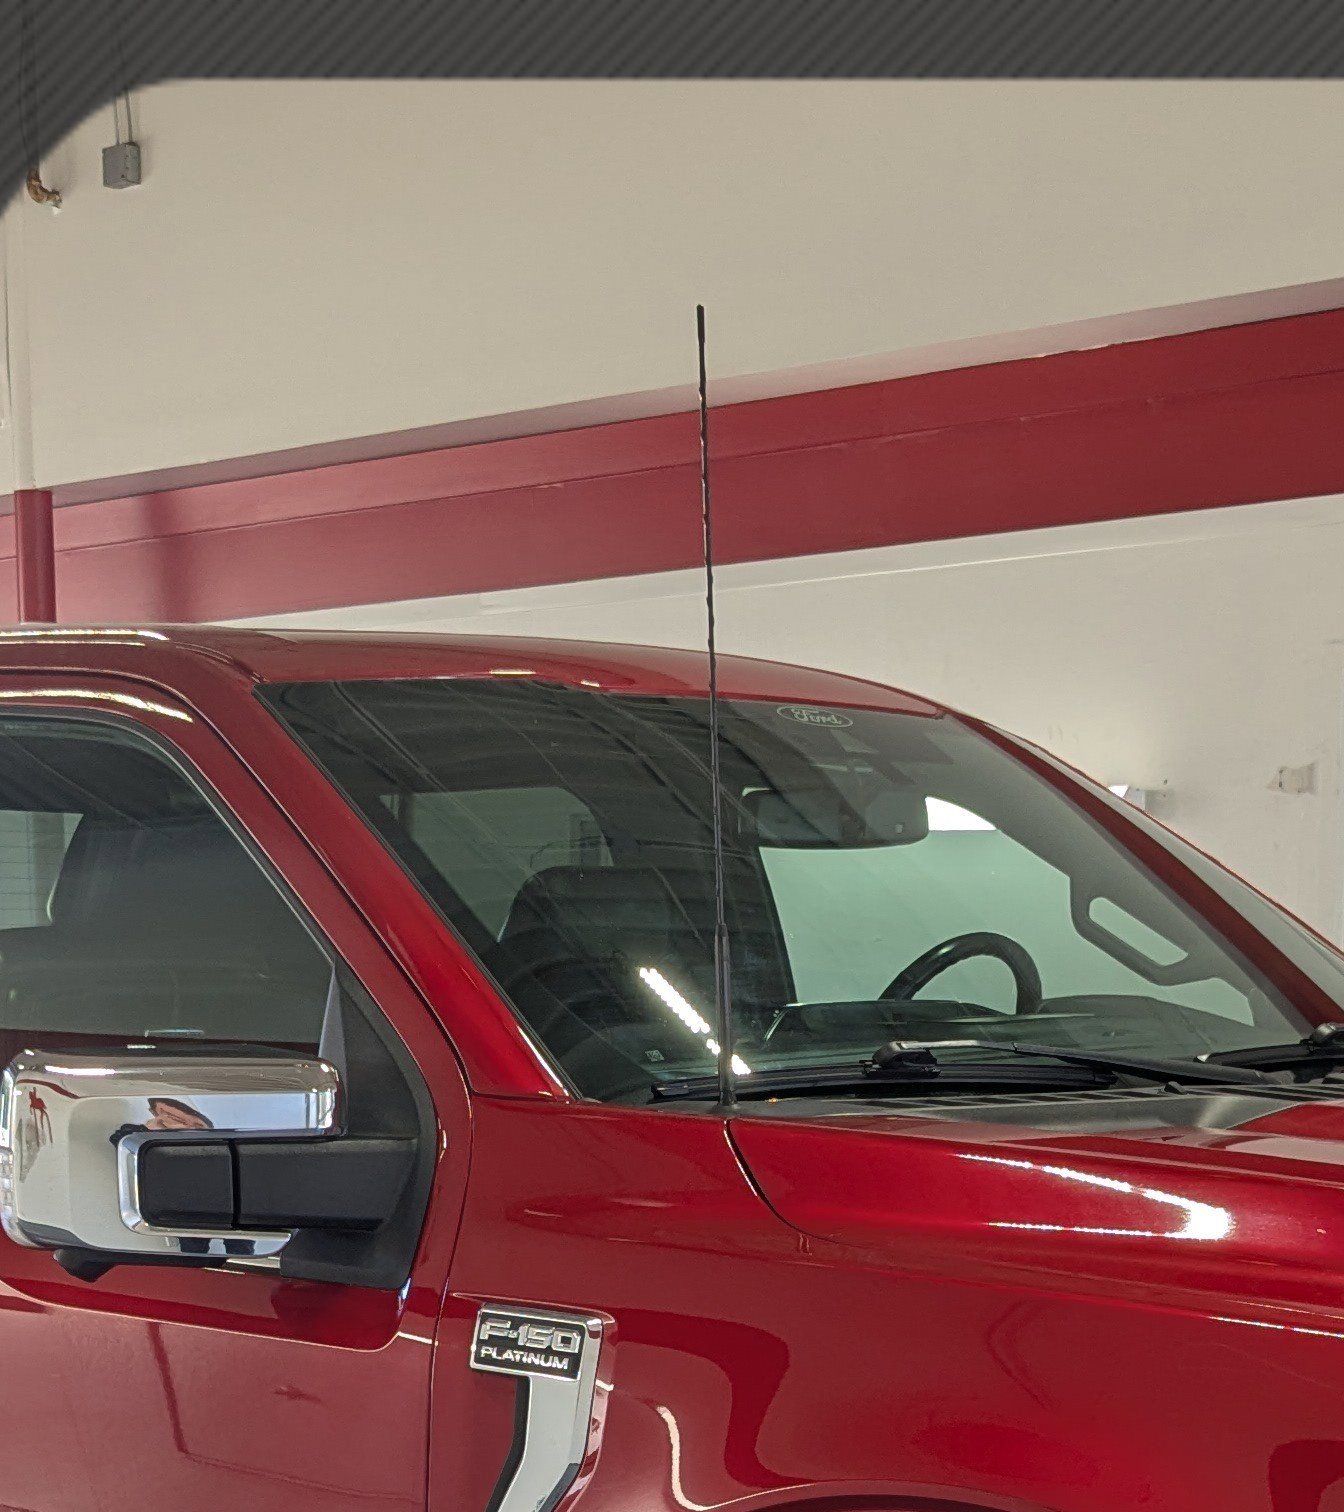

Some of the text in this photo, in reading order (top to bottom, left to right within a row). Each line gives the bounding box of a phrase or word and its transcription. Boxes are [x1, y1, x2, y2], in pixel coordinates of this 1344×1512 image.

[790, 707, 843, 725] Ford
[479, 1318, 581, 1353] F-150
[480, 1345, 570, 1370] PLATINUM
